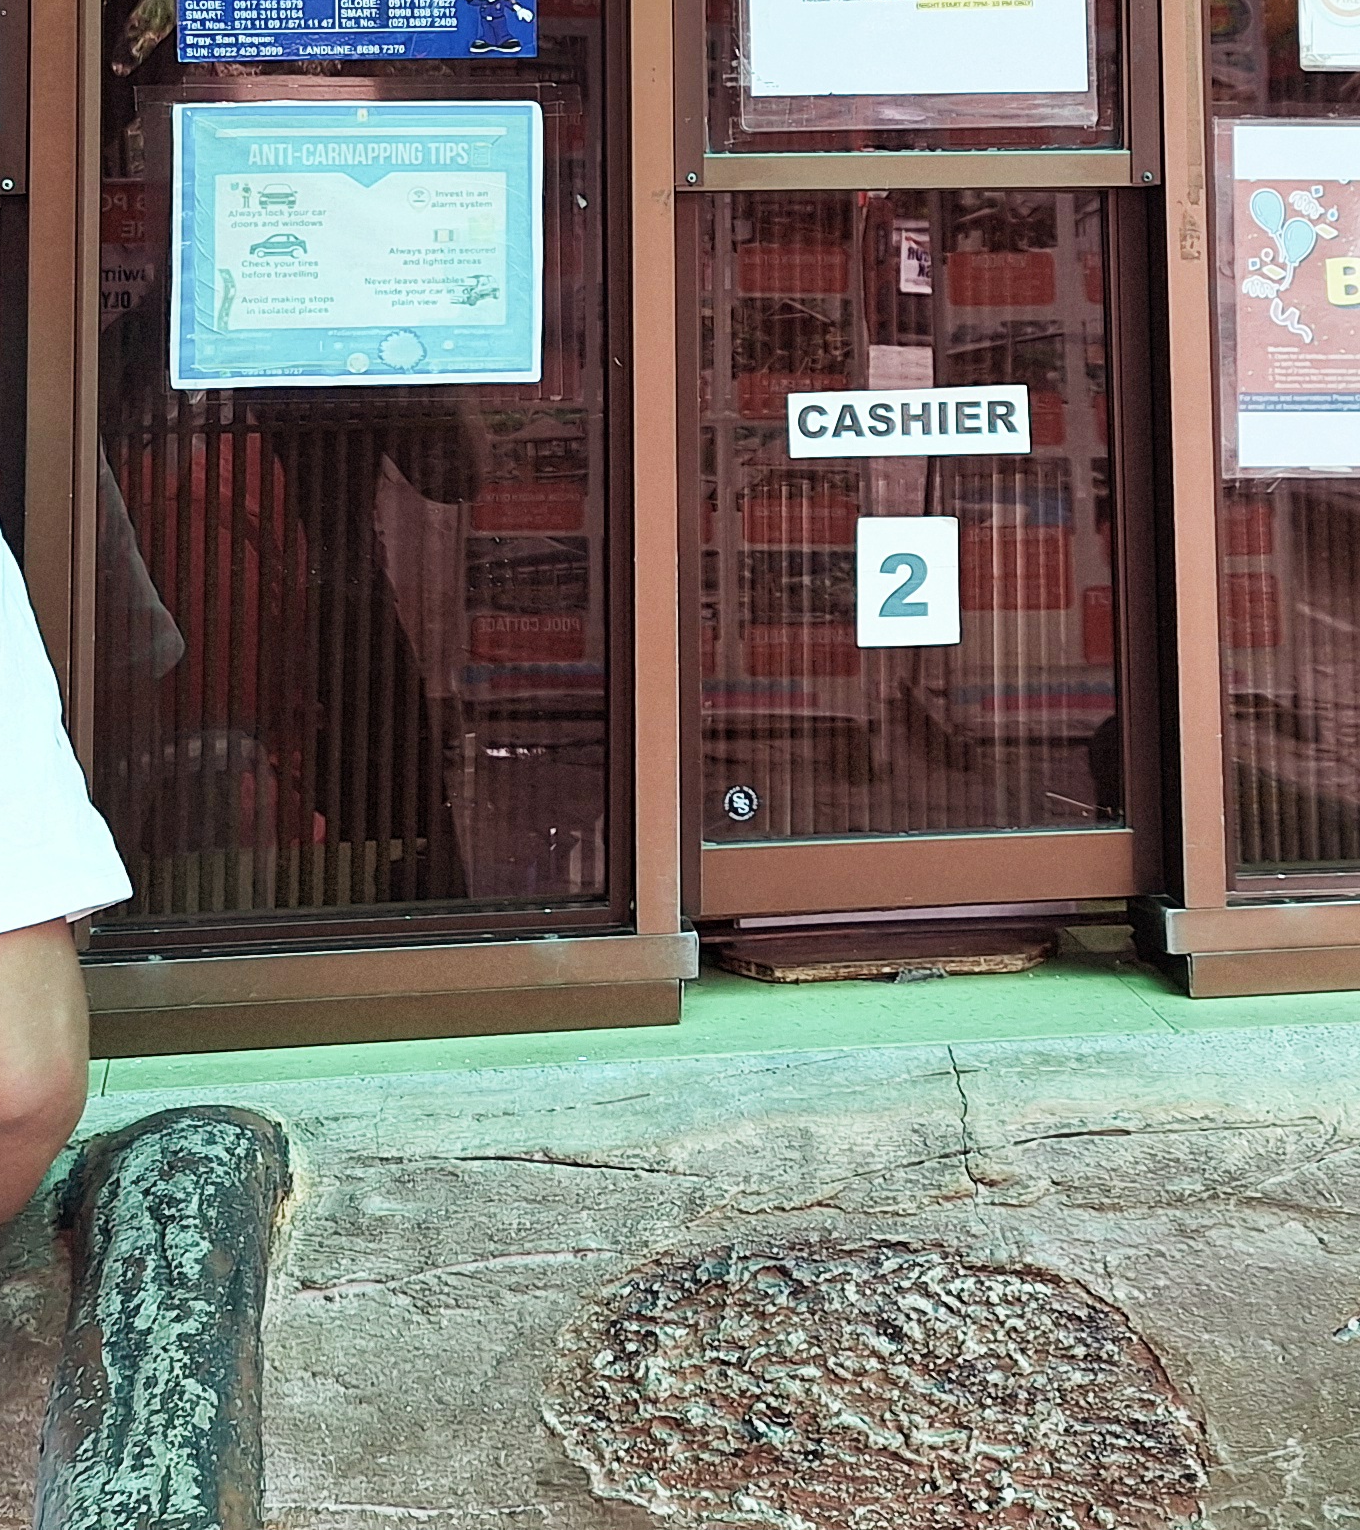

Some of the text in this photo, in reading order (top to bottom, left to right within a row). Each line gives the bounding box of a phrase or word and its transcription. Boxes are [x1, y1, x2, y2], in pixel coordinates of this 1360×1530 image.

[248, 143, 469, 166] ANTI-CARNAPPING TIPS
[435, 189, 461, 198] Invest
[465, 189, 473, 198] in
[798, 401, 1018, 438] CASHIER
[877, 551, 931, 619] 2
